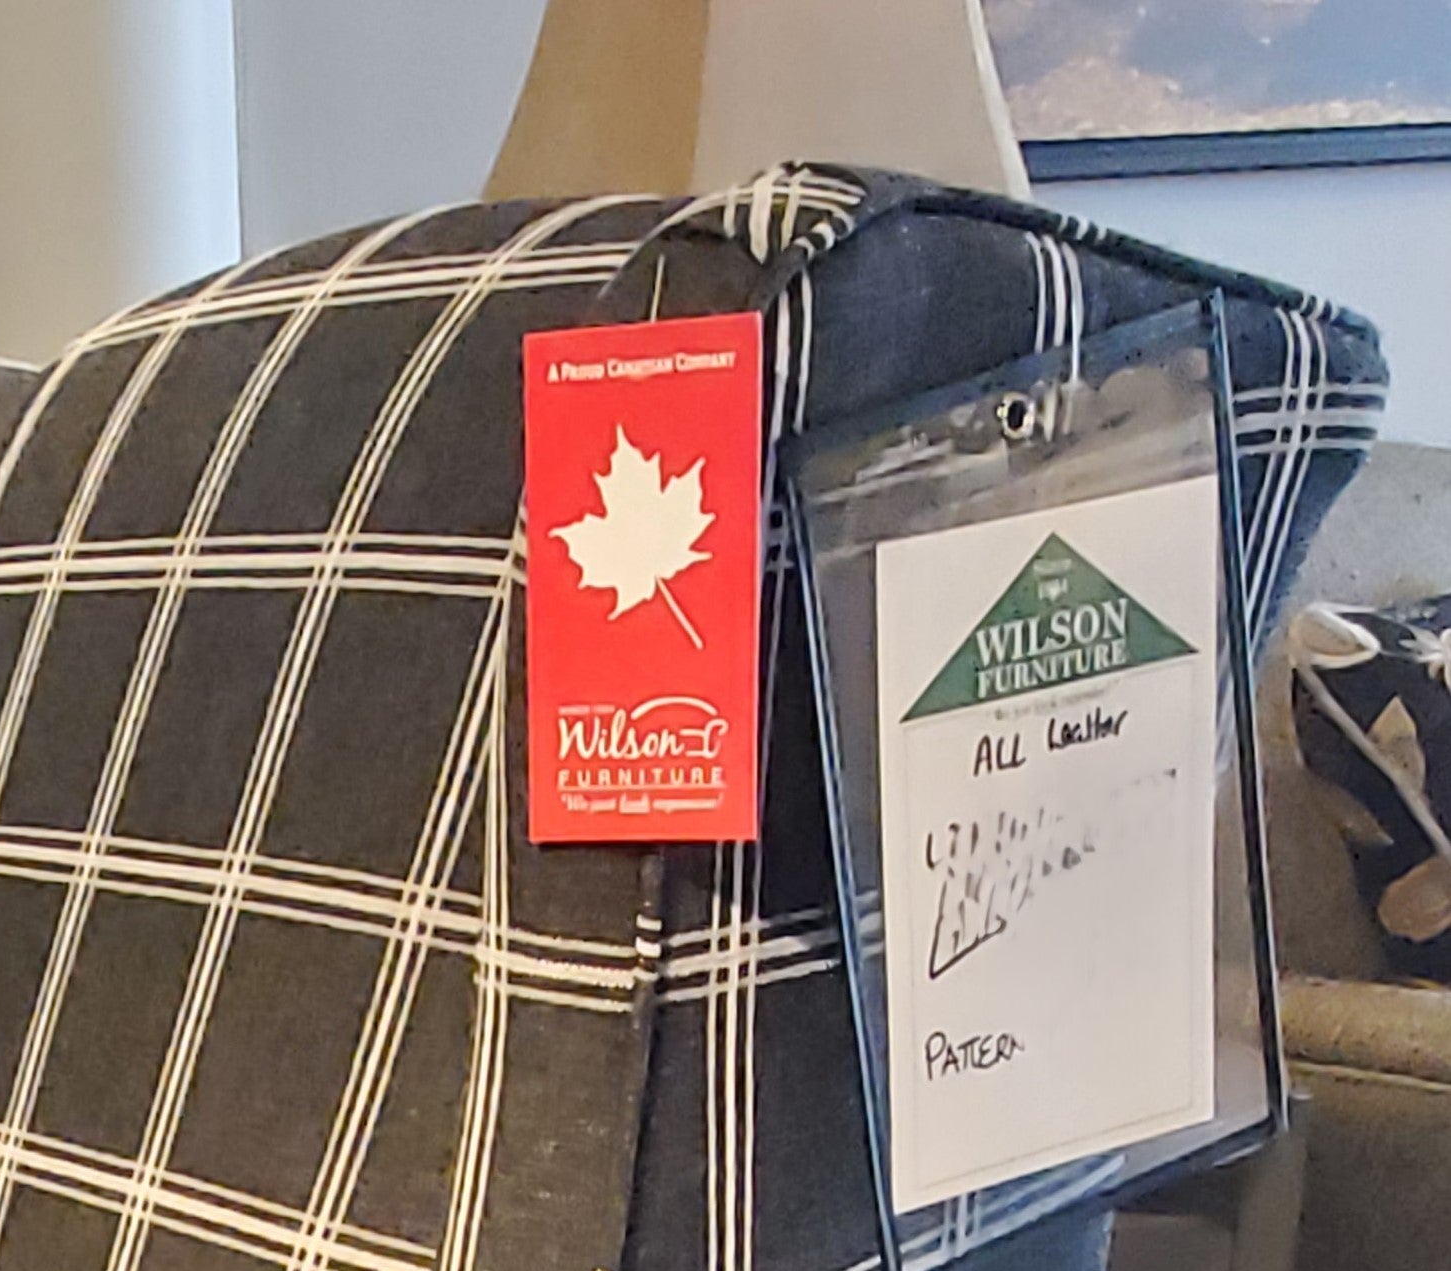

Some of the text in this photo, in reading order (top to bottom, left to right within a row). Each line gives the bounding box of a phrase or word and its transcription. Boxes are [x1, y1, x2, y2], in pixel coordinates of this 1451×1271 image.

[547, 362, 559, 383] A
[975, 598, 1129, 667] WILSON
[977, 637, 1127, 699] FURNITURE
[558, 708, 685, 760] Wilson
[973, 732, 1026, 777] ALL
[558, 766, 723, 788] FURNITURE
